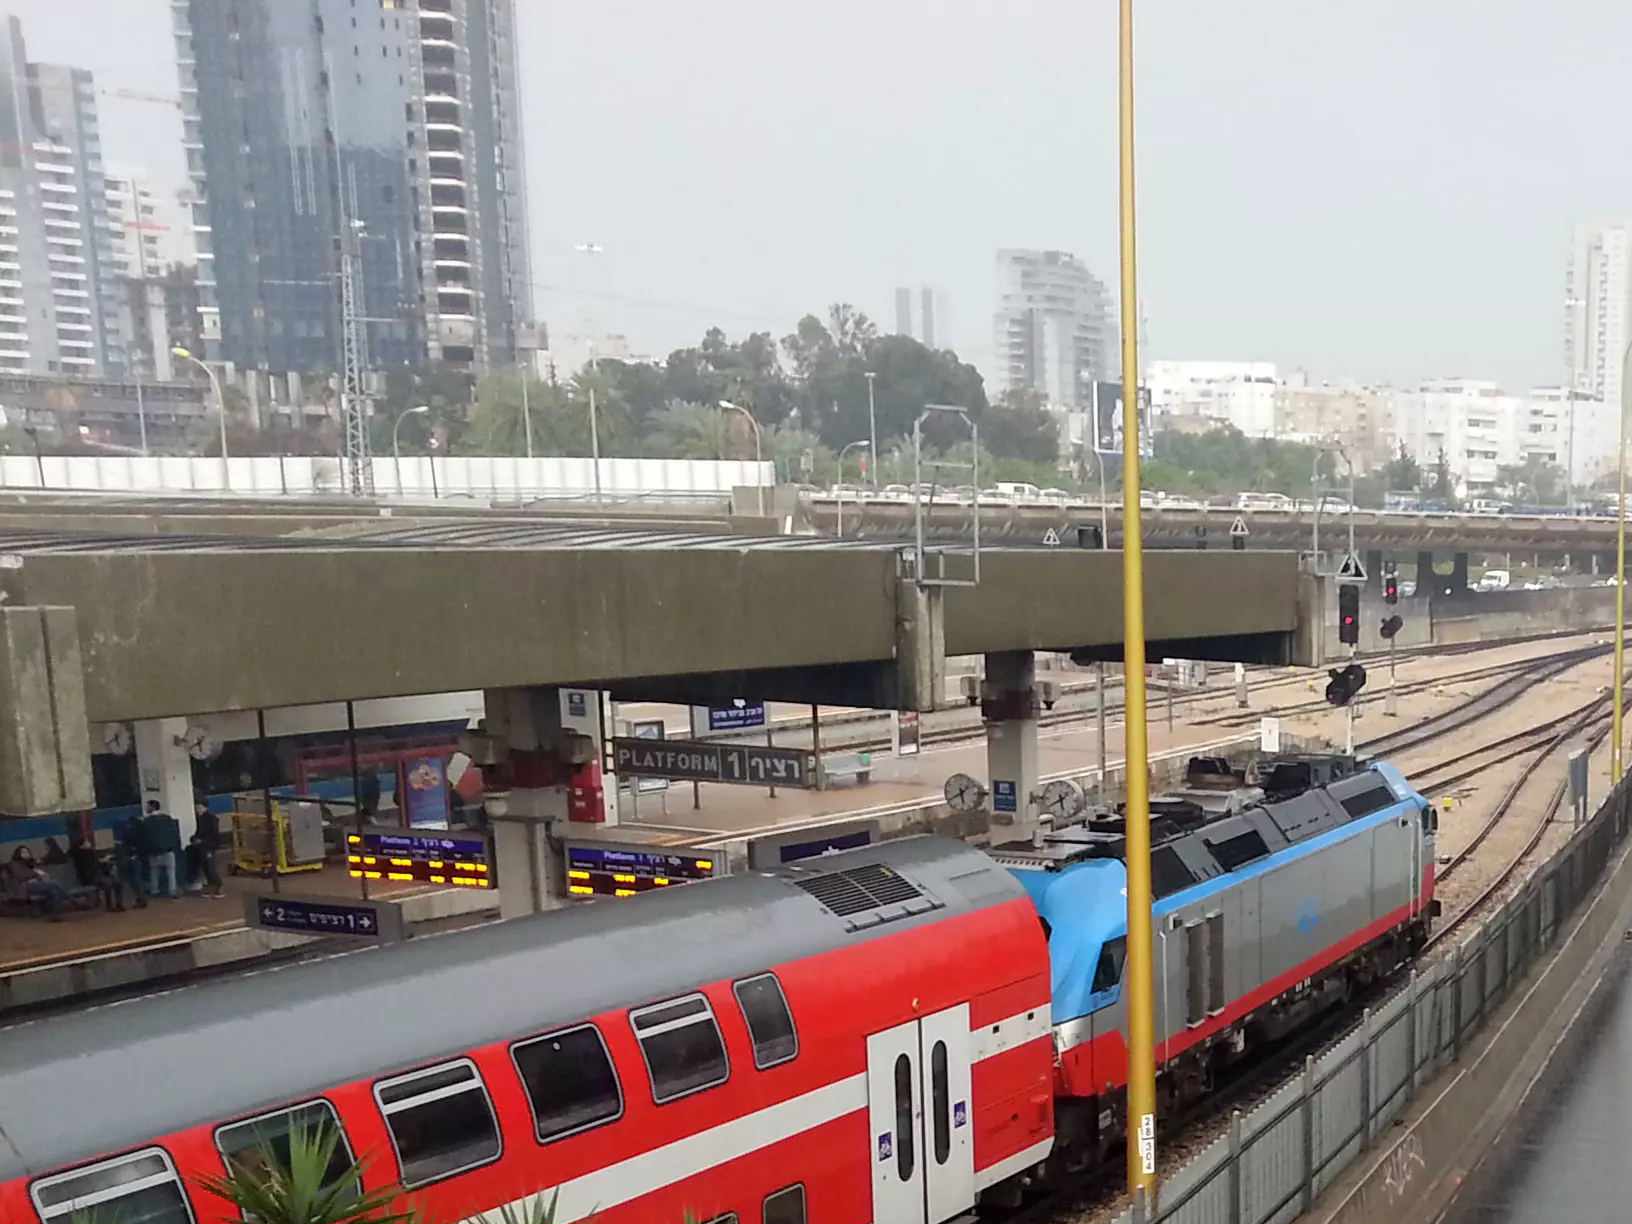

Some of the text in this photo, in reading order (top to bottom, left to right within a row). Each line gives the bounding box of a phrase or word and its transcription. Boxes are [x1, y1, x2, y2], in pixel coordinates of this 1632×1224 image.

[619, 749, 718, 772] PLATFORM
[727, 752, 741, 778] 1
[751, 756, 801, 779] רציף
[276, 907, 285, 921] 2
[347, 914, 355, 929] 1
